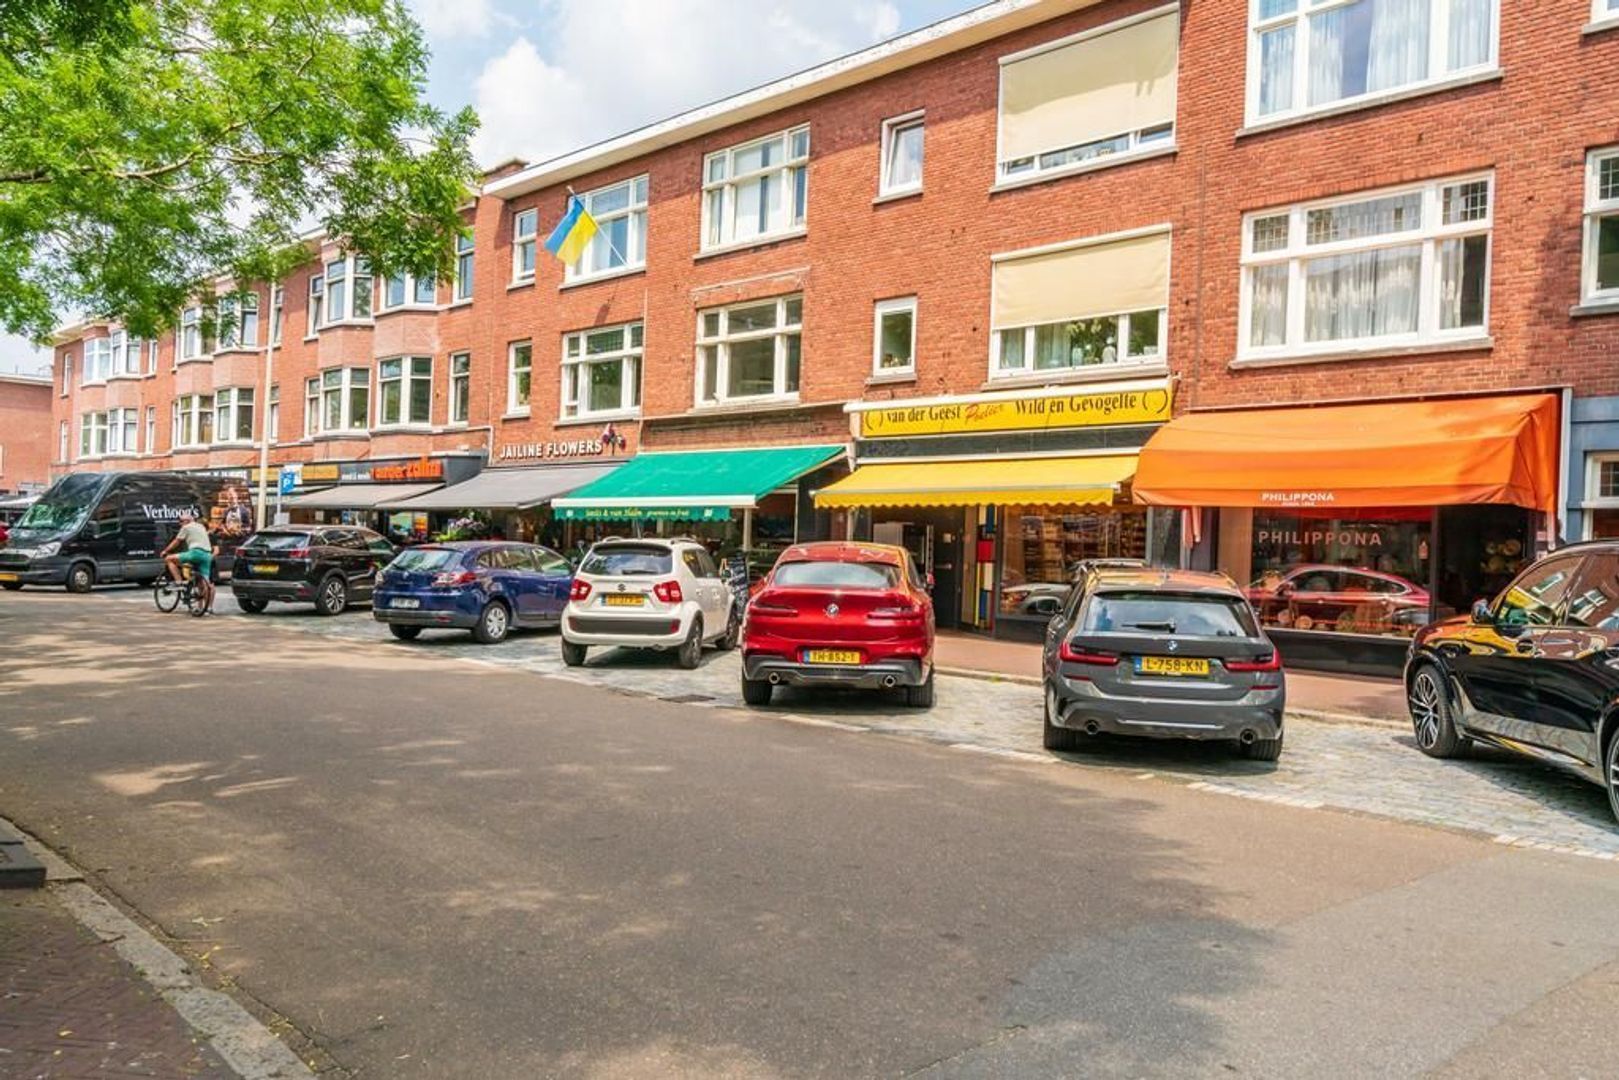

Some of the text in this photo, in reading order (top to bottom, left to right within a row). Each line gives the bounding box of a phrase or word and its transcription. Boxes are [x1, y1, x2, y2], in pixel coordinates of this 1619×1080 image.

[887, 410, 906, 423] van
[908, 407, 926, 423] der
[928, 406, 961, 422] Geest
[1015, 398, 1046, 415] Wild
[1050, 399, 1064, 413] en
[1069, 393, 1137, 415] Gevogelte
[500, 439, 603, 459] JAILINE FLOWERS
[1261, 492, 1335, 502] PHILIPPONA
[1258, 530, 1382, 547] PHILIPPONA
[1144, 658, 1205, 674] L-758-KN
